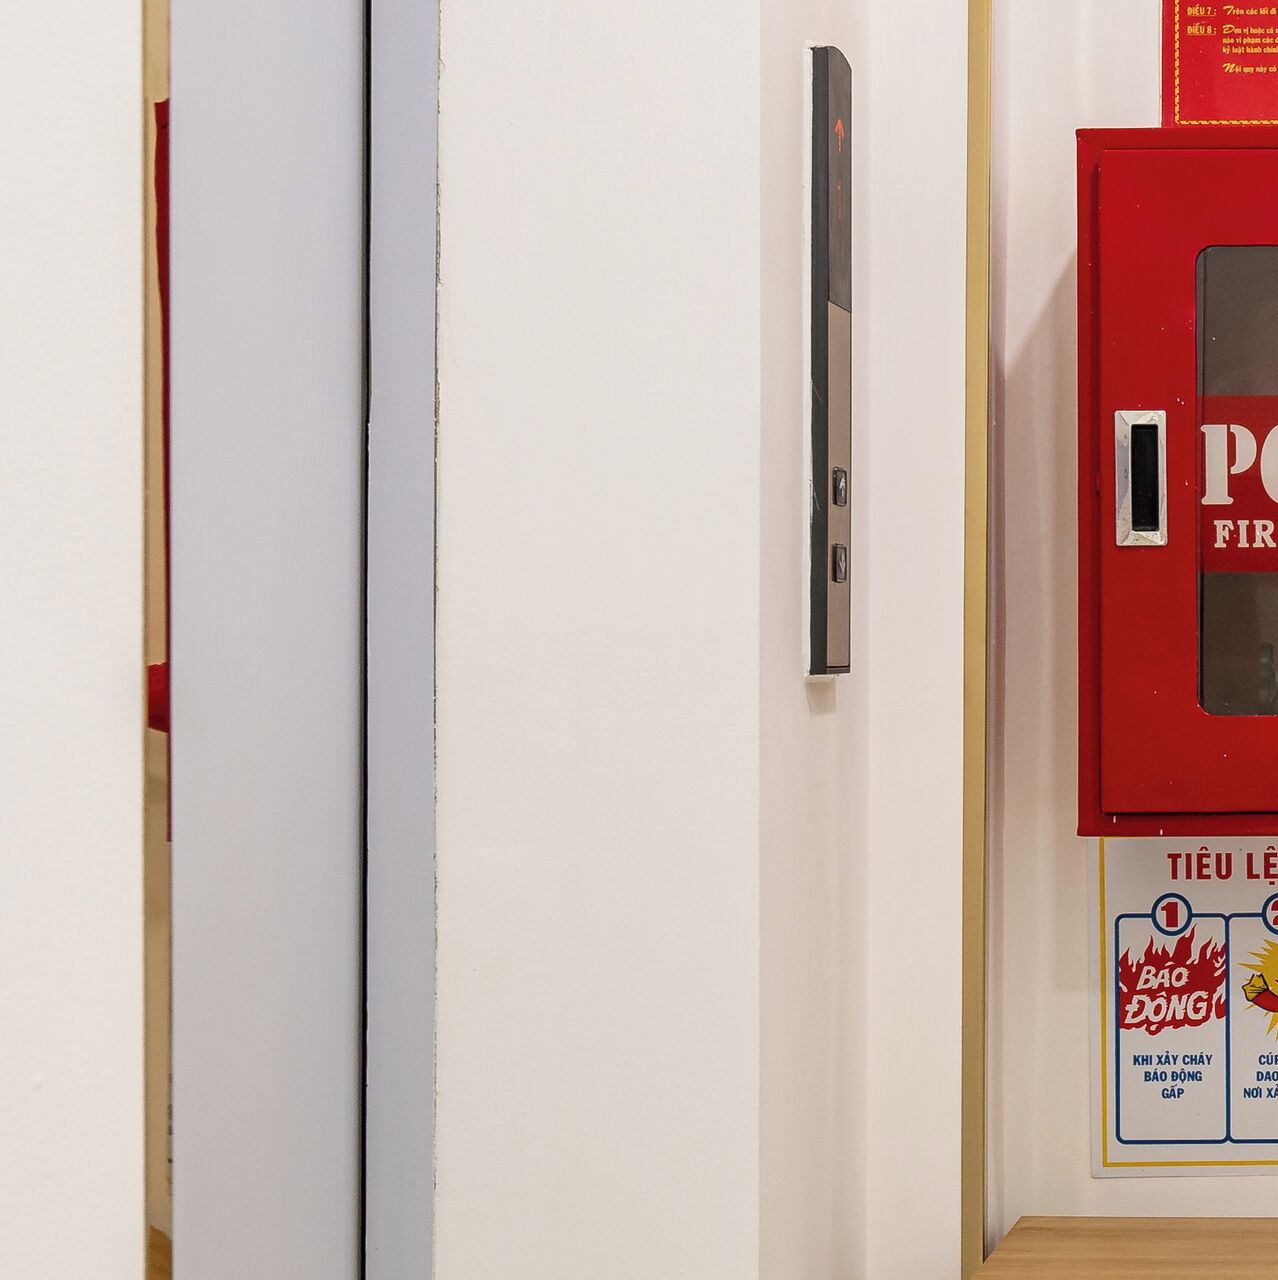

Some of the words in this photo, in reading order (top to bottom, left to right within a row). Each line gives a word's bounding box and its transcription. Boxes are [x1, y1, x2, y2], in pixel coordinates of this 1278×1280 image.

[1167, 847, 1233, 881] TIÊU
[1161, 901, 1179, 928] 1
[1136, 961, 1189, 990] BÁO
[1124, 991, 1208, 1030] ĐỘNG
[1133, 1055, 1152, 1066] KHI
[1156, 1050, 1179, 1065] XẢY
[1182, 1052, 1213, 1065] CHÁY
[1144, 1068, 1168, 1082] BÁO
[1171, 1068, 1202, 1085] ĐỘNG
[1161, 1084, 1184, 1099] GẤP
[1243, 1086, 1262, 1098] NƠI
